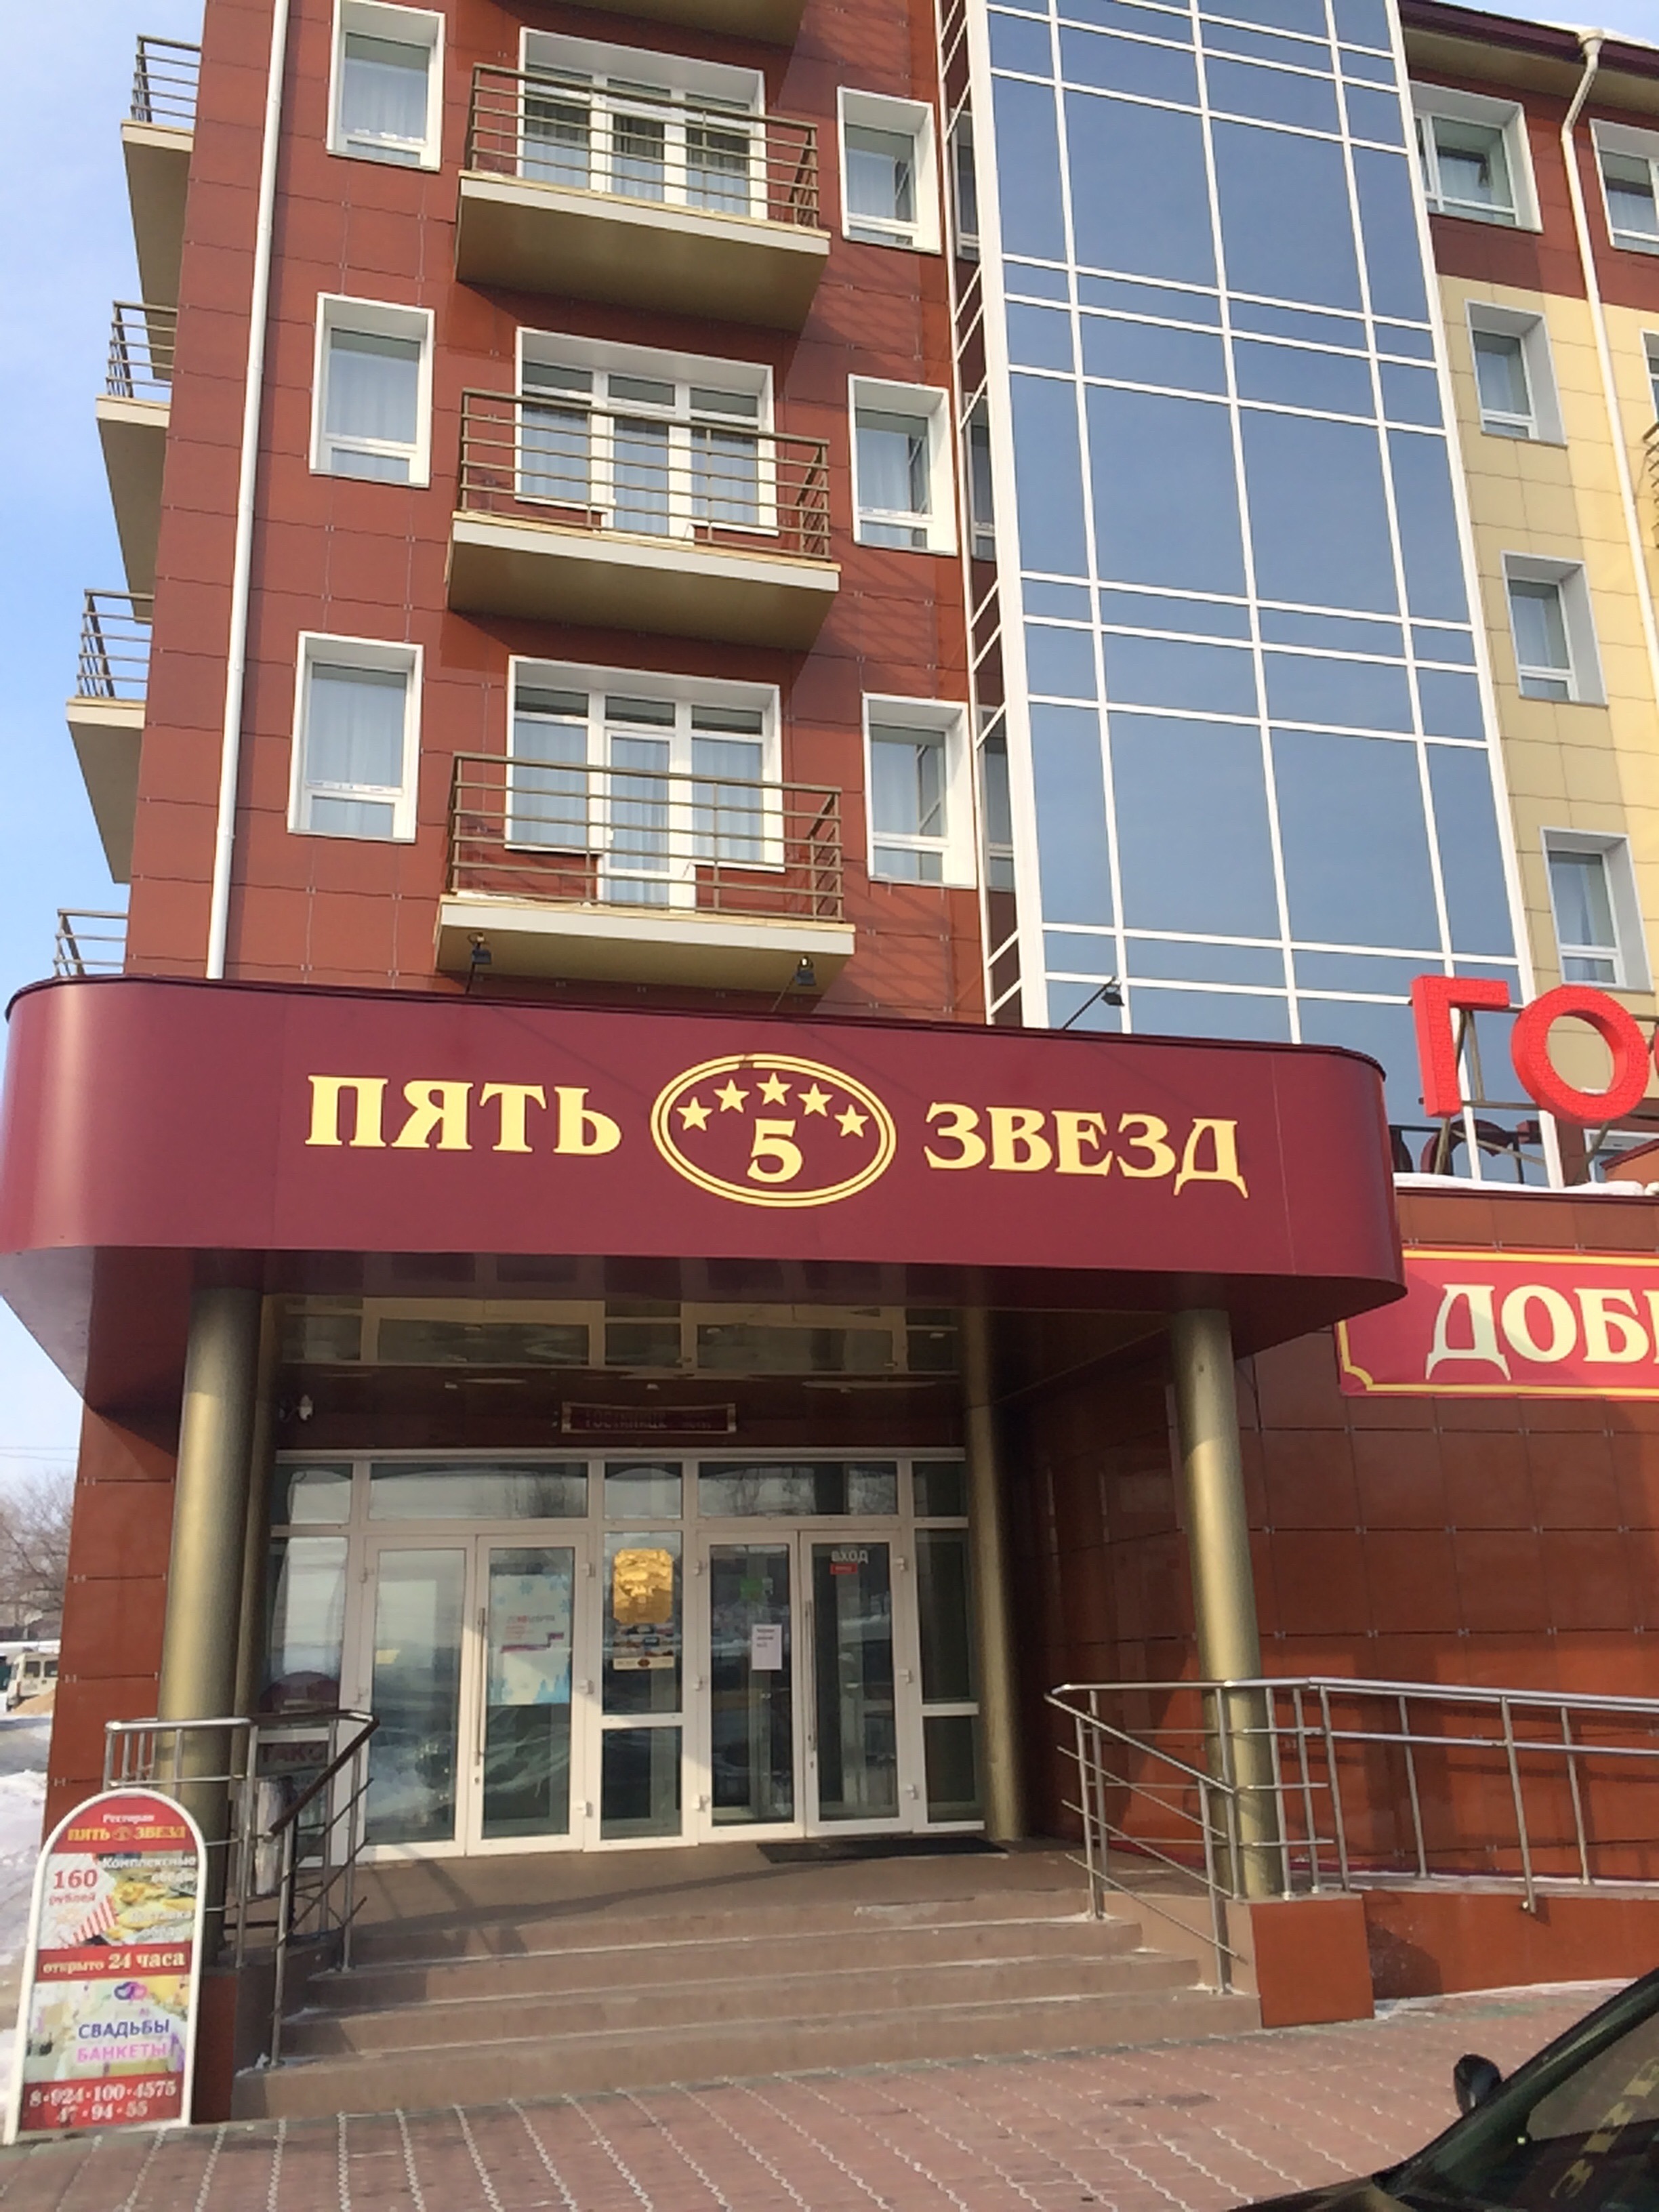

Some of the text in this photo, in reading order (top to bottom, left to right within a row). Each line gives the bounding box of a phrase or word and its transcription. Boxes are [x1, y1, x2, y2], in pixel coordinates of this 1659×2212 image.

[1410, 975, 1659, 1124] ГО
[305, 1075, 1249, 1198] ПЯТЬ 5 ЗВЕЗД
[54, 1868, 98, 1889] 160
[43, 1952, 185, 1975] открыто 24 часа
[78, 2019, 169, 2039] СВАДЬБЫ
[77, 2042, 167, 2063] БАНКЕТЫ
